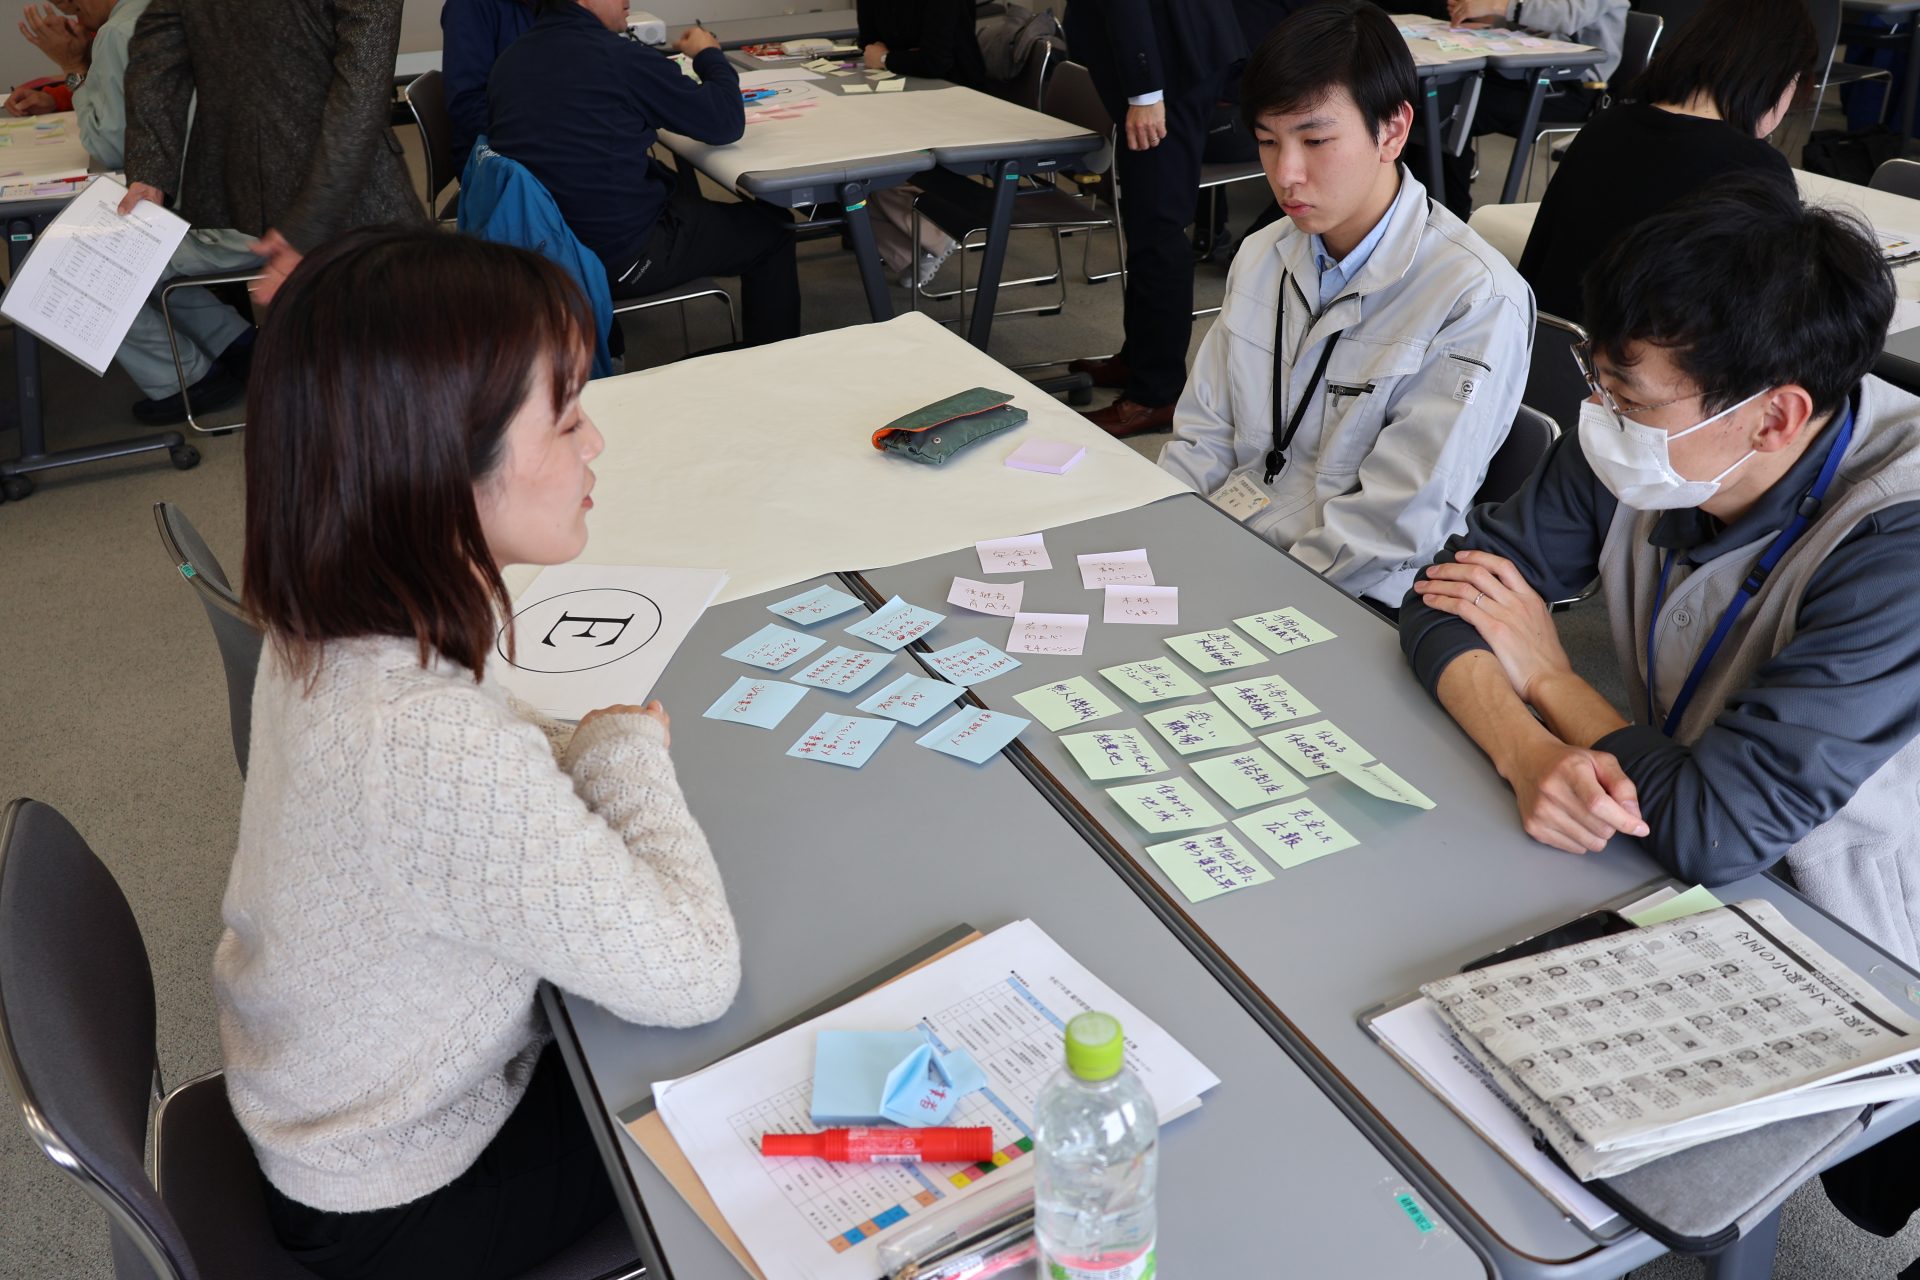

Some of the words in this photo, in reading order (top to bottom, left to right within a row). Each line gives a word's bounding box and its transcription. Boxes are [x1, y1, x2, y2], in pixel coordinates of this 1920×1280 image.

[541, 611, 636, 647] E
[1162, 720, 1204, 745] 職場
[1184, 710, 1216, 737] 楽しい
[1315, 731, 1346, 752] 休める
[1231, 756, 1284, 795] 資格制度
[1137, 796, 1178, 822] 地域
[1262, 822, 1303, 850] 広報
[1288, 809, 1333, 843] 充実した
[1205, 837, 1256, 882] 物価上昇に
[1734, 930, 1879, 1037] 全国の小選挙区当選者
